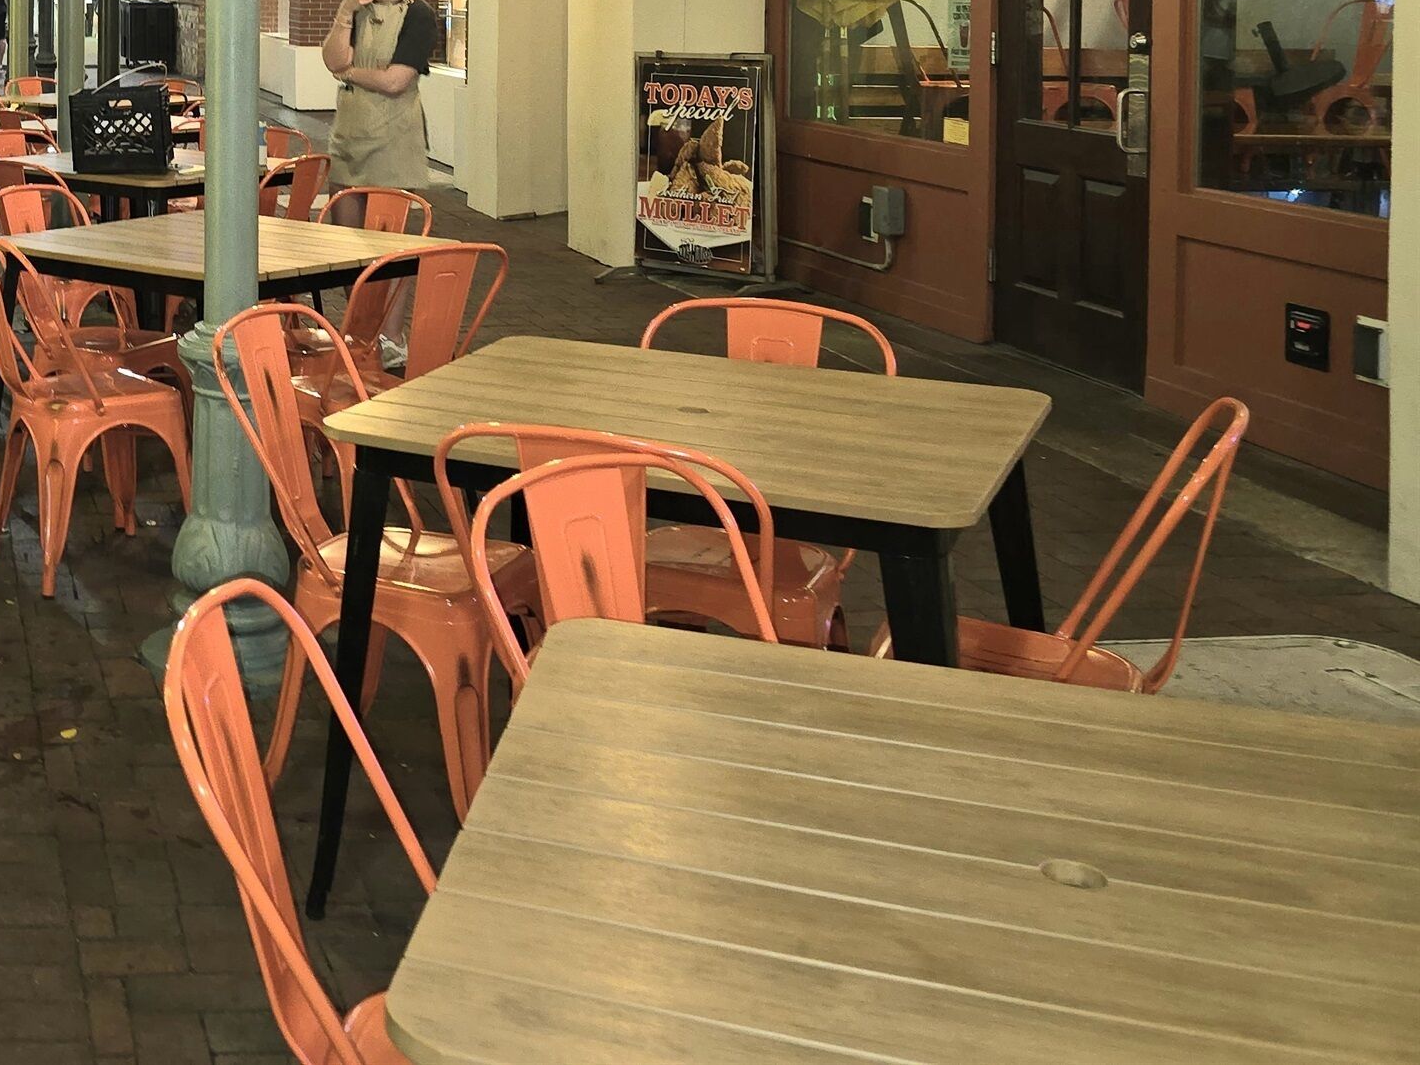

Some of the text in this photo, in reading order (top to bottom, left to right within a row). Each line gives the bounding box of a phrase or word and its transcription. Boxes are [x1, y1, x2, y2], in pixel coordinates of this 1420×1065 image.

[644, 82, 753, 110] TODAY'S
[662, 95, 739, 131] special
[638, 195, 751, 231] MULLET
